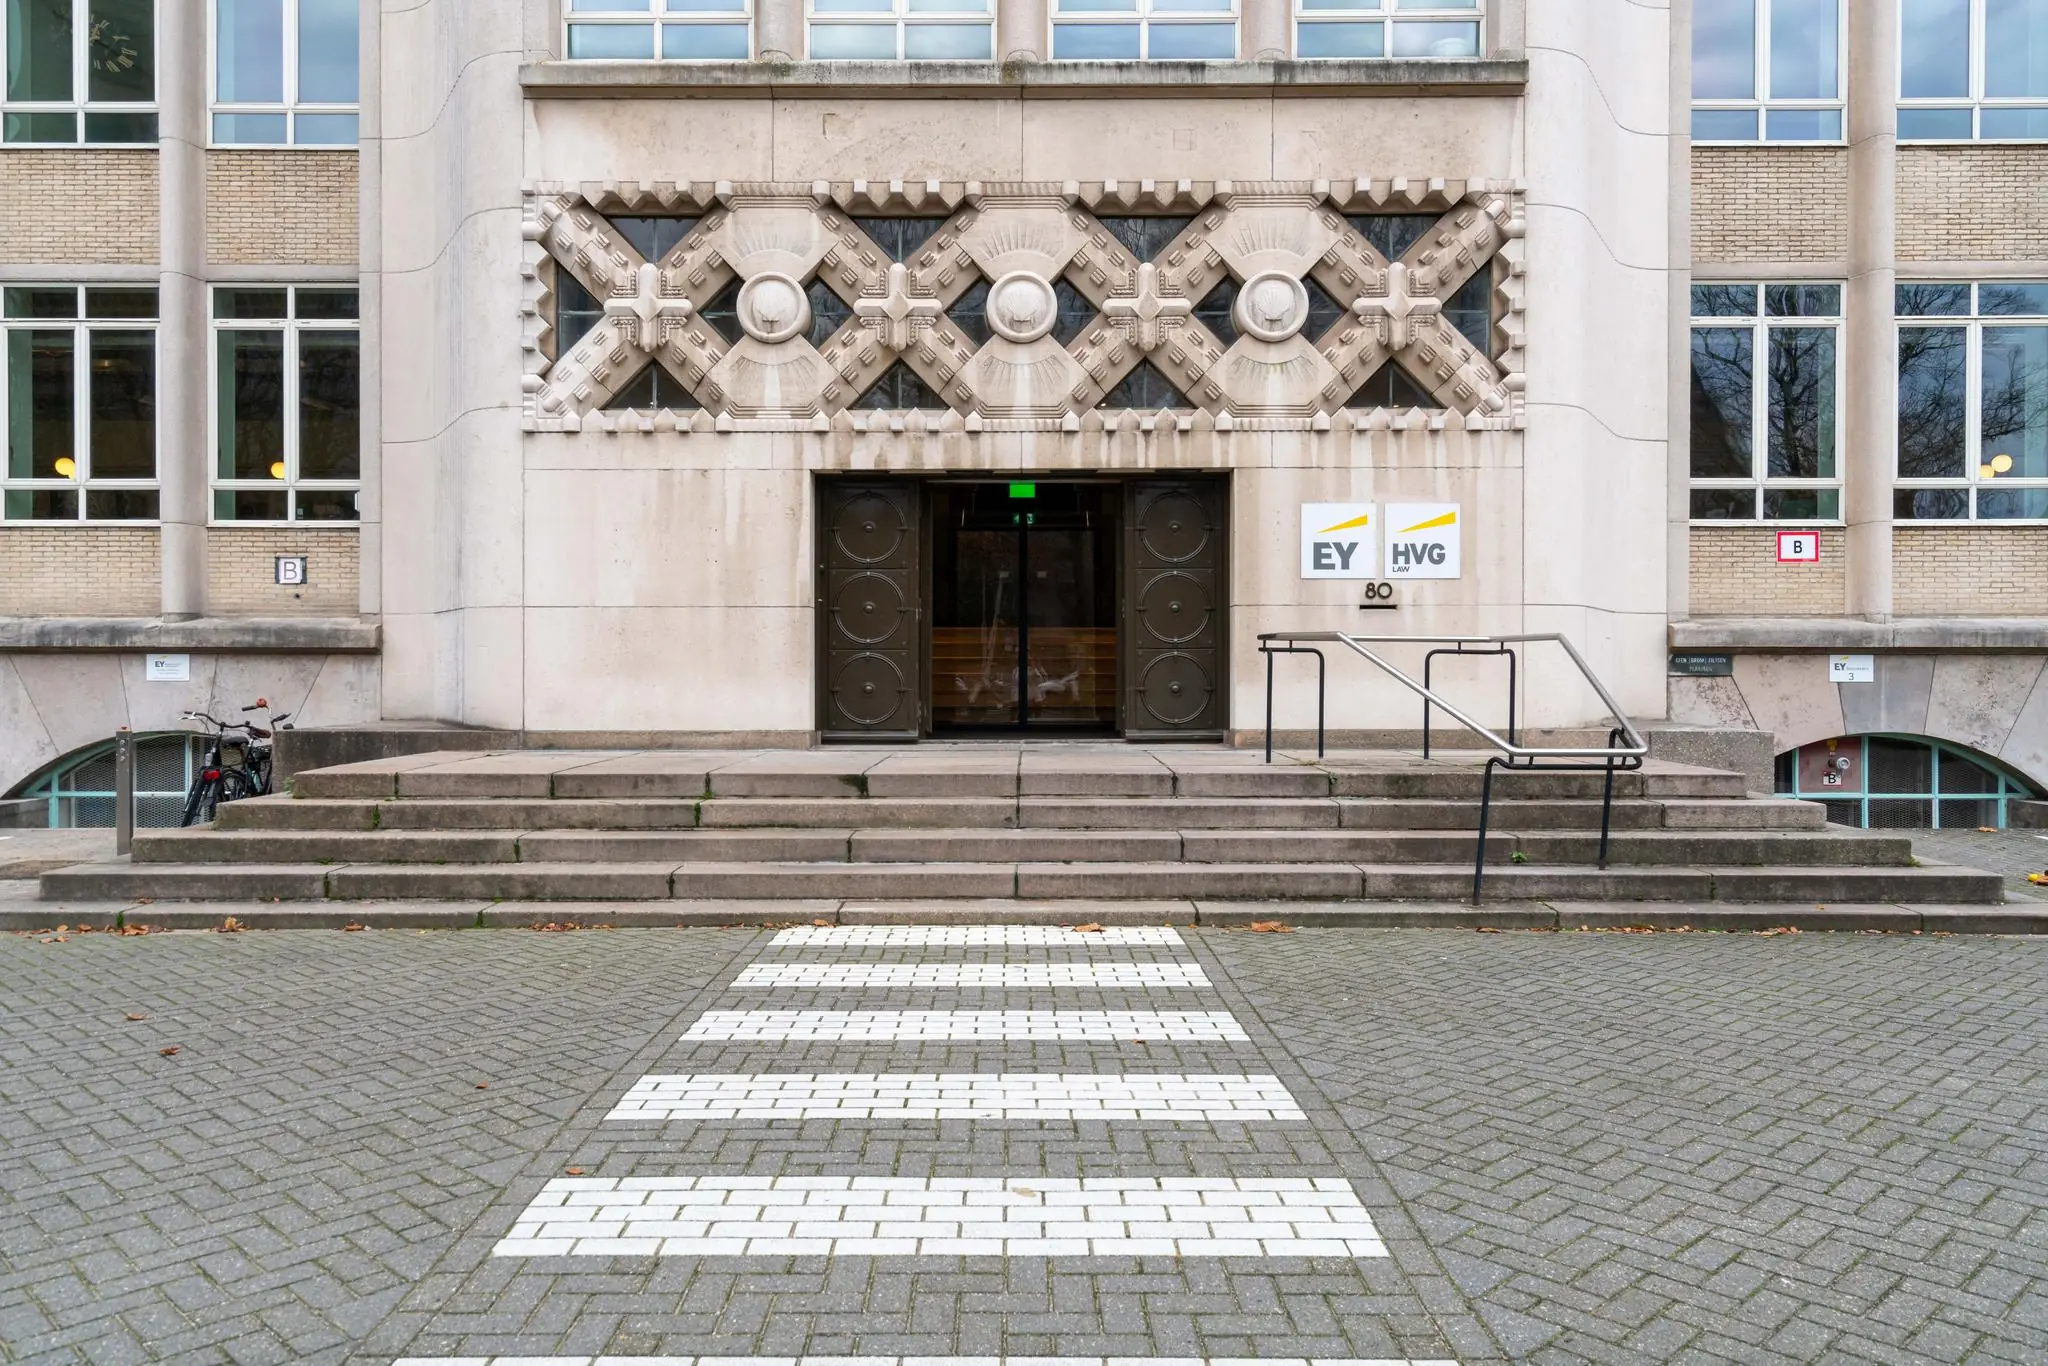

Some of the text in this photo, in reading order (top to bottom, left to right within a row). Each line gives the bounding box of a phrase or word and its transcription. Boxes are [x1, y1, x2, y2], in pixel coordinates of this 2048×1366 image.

[1392, 543, 1446, 565] HVG
[1794, 540, 1803, 553] B
[1313, 542, 1359, 570] EY
[284, 561, 297, 580] B
[1365, 582, 1393, 599] 80
[1834, 663, 1846, 671] EY
[1848, 672, 1855, 681] 3
[1828, 773, 1836, 784] B
